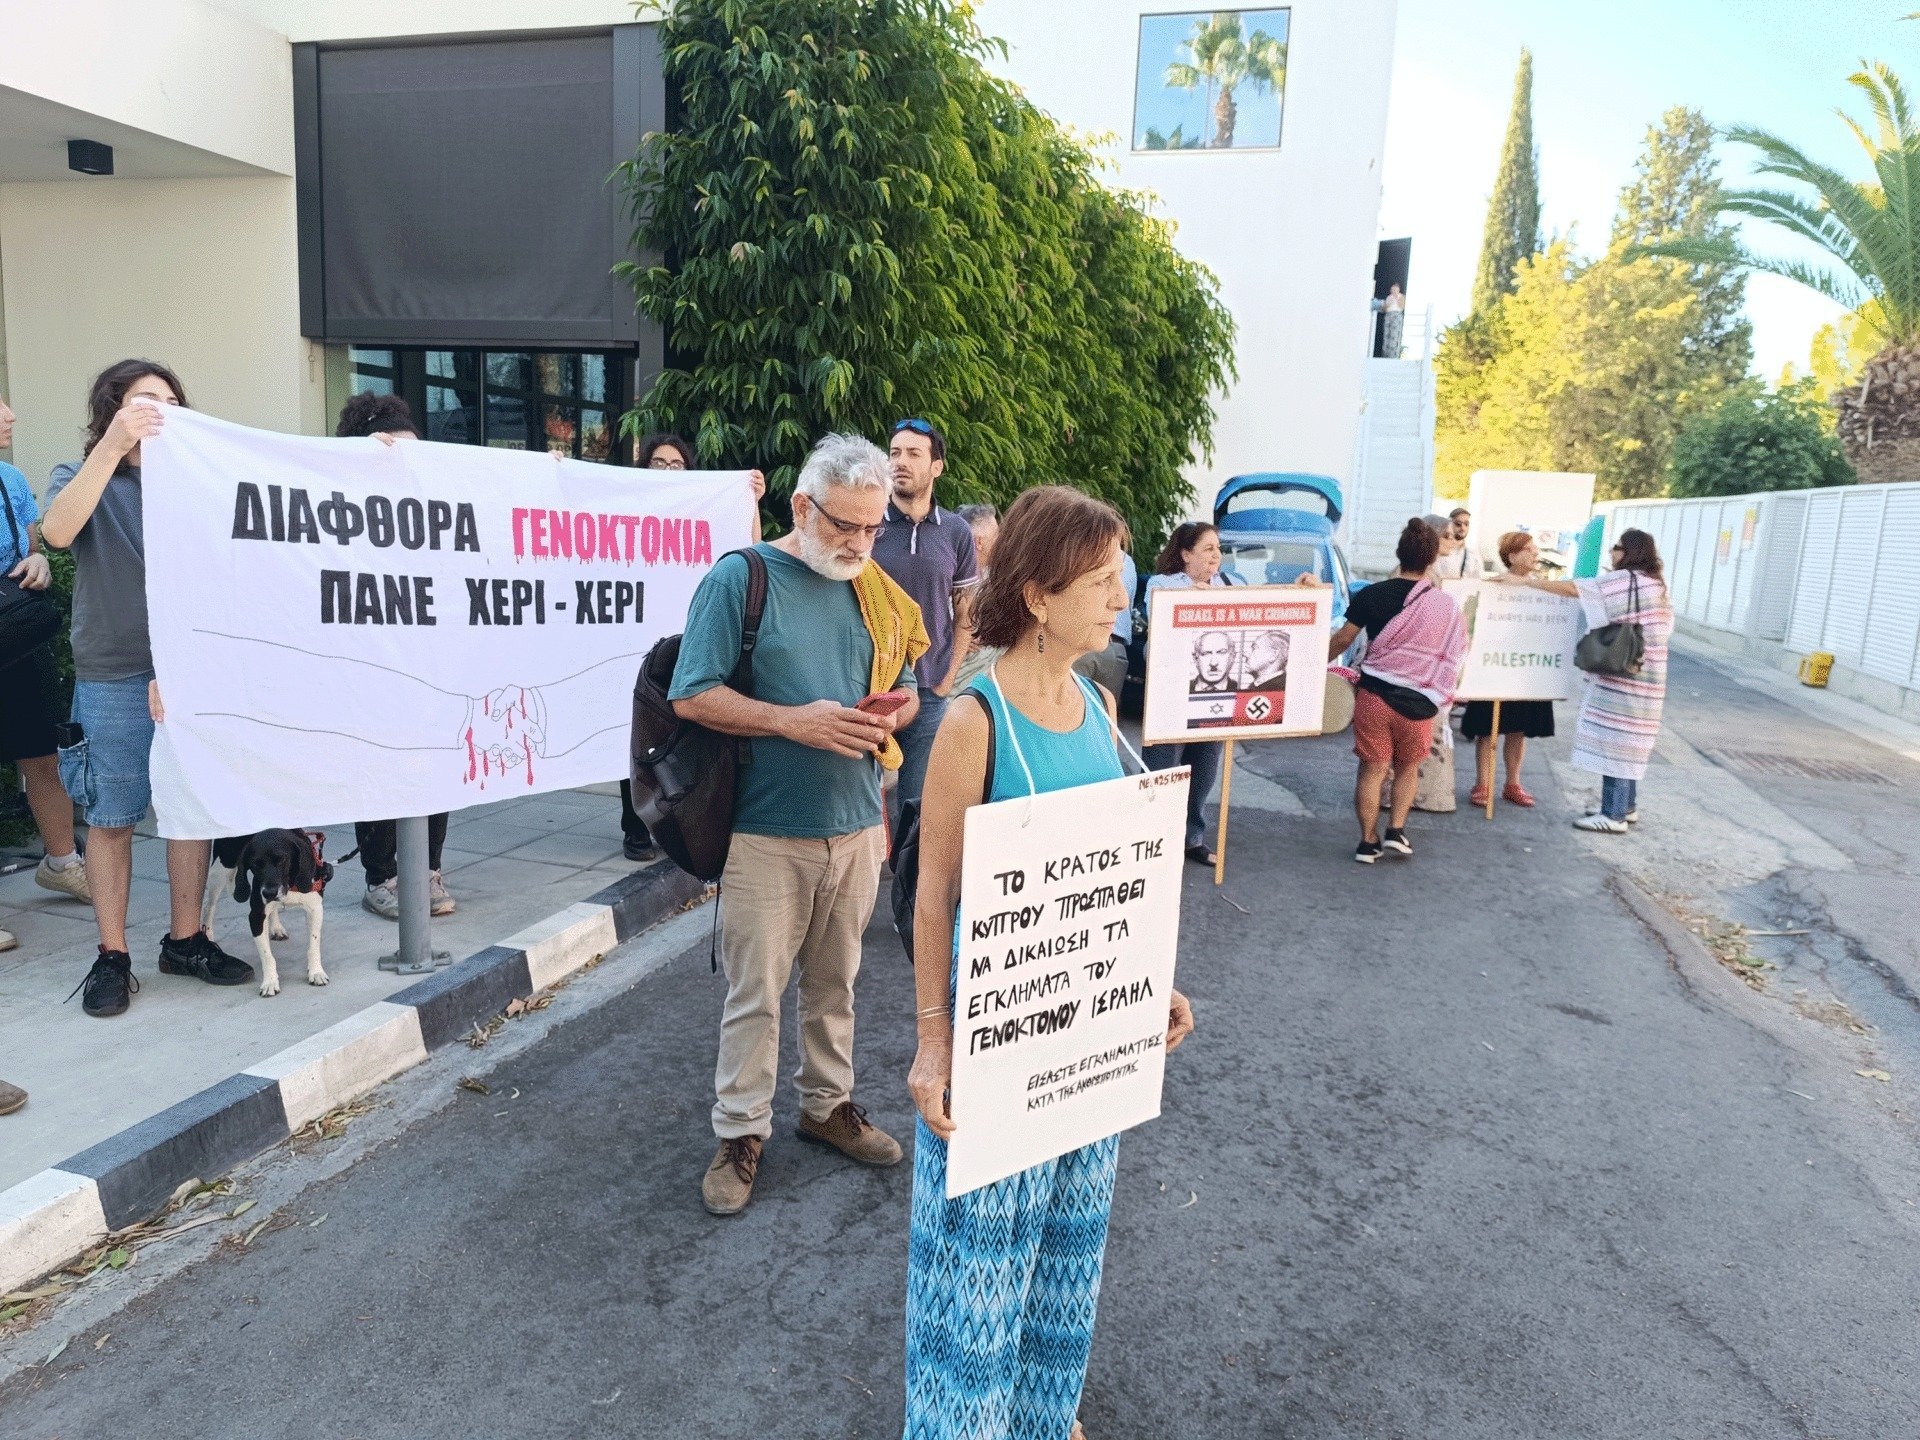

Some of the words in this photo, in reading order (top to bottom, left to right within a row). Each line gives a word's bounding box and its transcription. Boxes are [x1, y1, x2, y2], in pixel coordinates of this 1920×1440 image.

[232, 481, 480, 552] ΔΙΑΦΘΟΡΑ
[512, 507, 712, 568] ΓΕΝΟΚΤΟΝΙΑ
[320, 569, 437, 626] ΠΑΝΕ
[465, 578, 546, 626] ΧΕΡΙ
[575, 580, 645, 624] ΧΕΡΙ
[1482, 652, 1562, 668] PALESTINE
[994, 870, 1025, 896] ΤΟ
[1044, 847, 1121, 884] ΚΡΑΤΟΣ
[1131, 838, 1163, 862] ΤΗΣ
[972, 904, 1044, 941] ΚΥΠΡΟΥ
[1055, 878, 1146, 921] ΠΡΟΣΠΑΘΕΙ
[970, 956, 991, 979] ΝΑ
[1004, 929, 1089, 970] ΔΙΚΑΙΩΣΗ
[1103, 918, 1129, 942] ΤΑ
[968, 971, 1070, 1019] ΕΓΚΛΗΜΑΤΑ
[1083, 957, 1117, 981] ΤΟΥ
[970, 999, 1081, 1056] ΓΕΝΟΚΤΟΝΟΥ
[1092, 976, 1153, 1018] ΙΣΡΑΗΛ
[1027, 1063, 1078, 1092] ΕΙΣΑΣΤΕ
[1079, 1032, 1163, 1072] ΕΓΚΛΗΜΑΤΙΕΣ
[1027, 1092, 1055, 1112] ΚΑΤΑ
[1055, 1082, 1078, 1102] ΤΗΣ
[1075, 1060, 1139, 1095] ΑΝΘΡΩΠΟΤΗΤΑΣ
